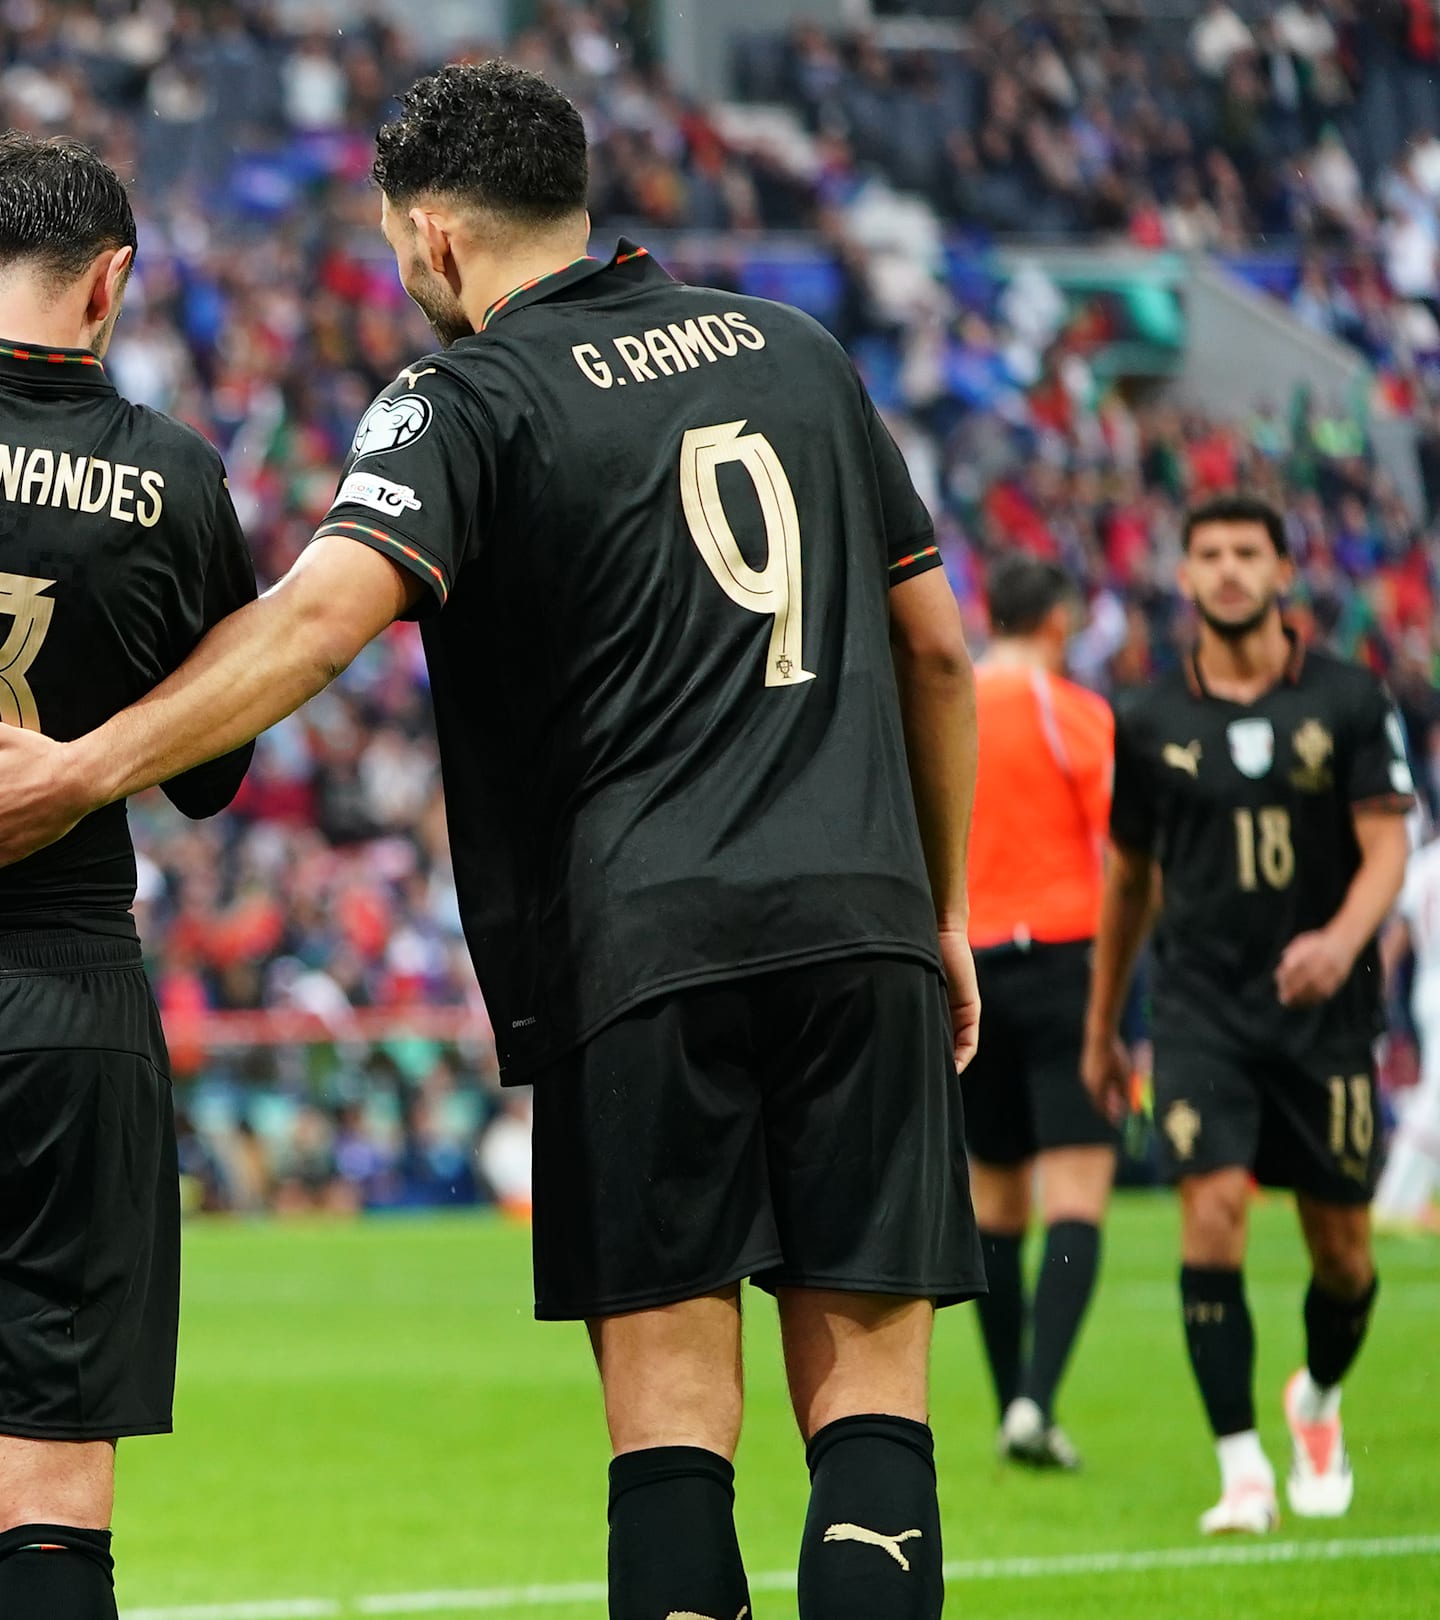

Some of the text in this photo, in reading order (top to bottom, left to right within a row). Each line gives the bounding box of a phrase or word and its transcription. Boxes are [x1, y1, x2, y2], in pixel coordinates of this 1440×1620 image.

[680, 419, 817, 688] 9
[1233, 806, 1295, 892] 18
[1327, 1073, 1374, 1157] 18
